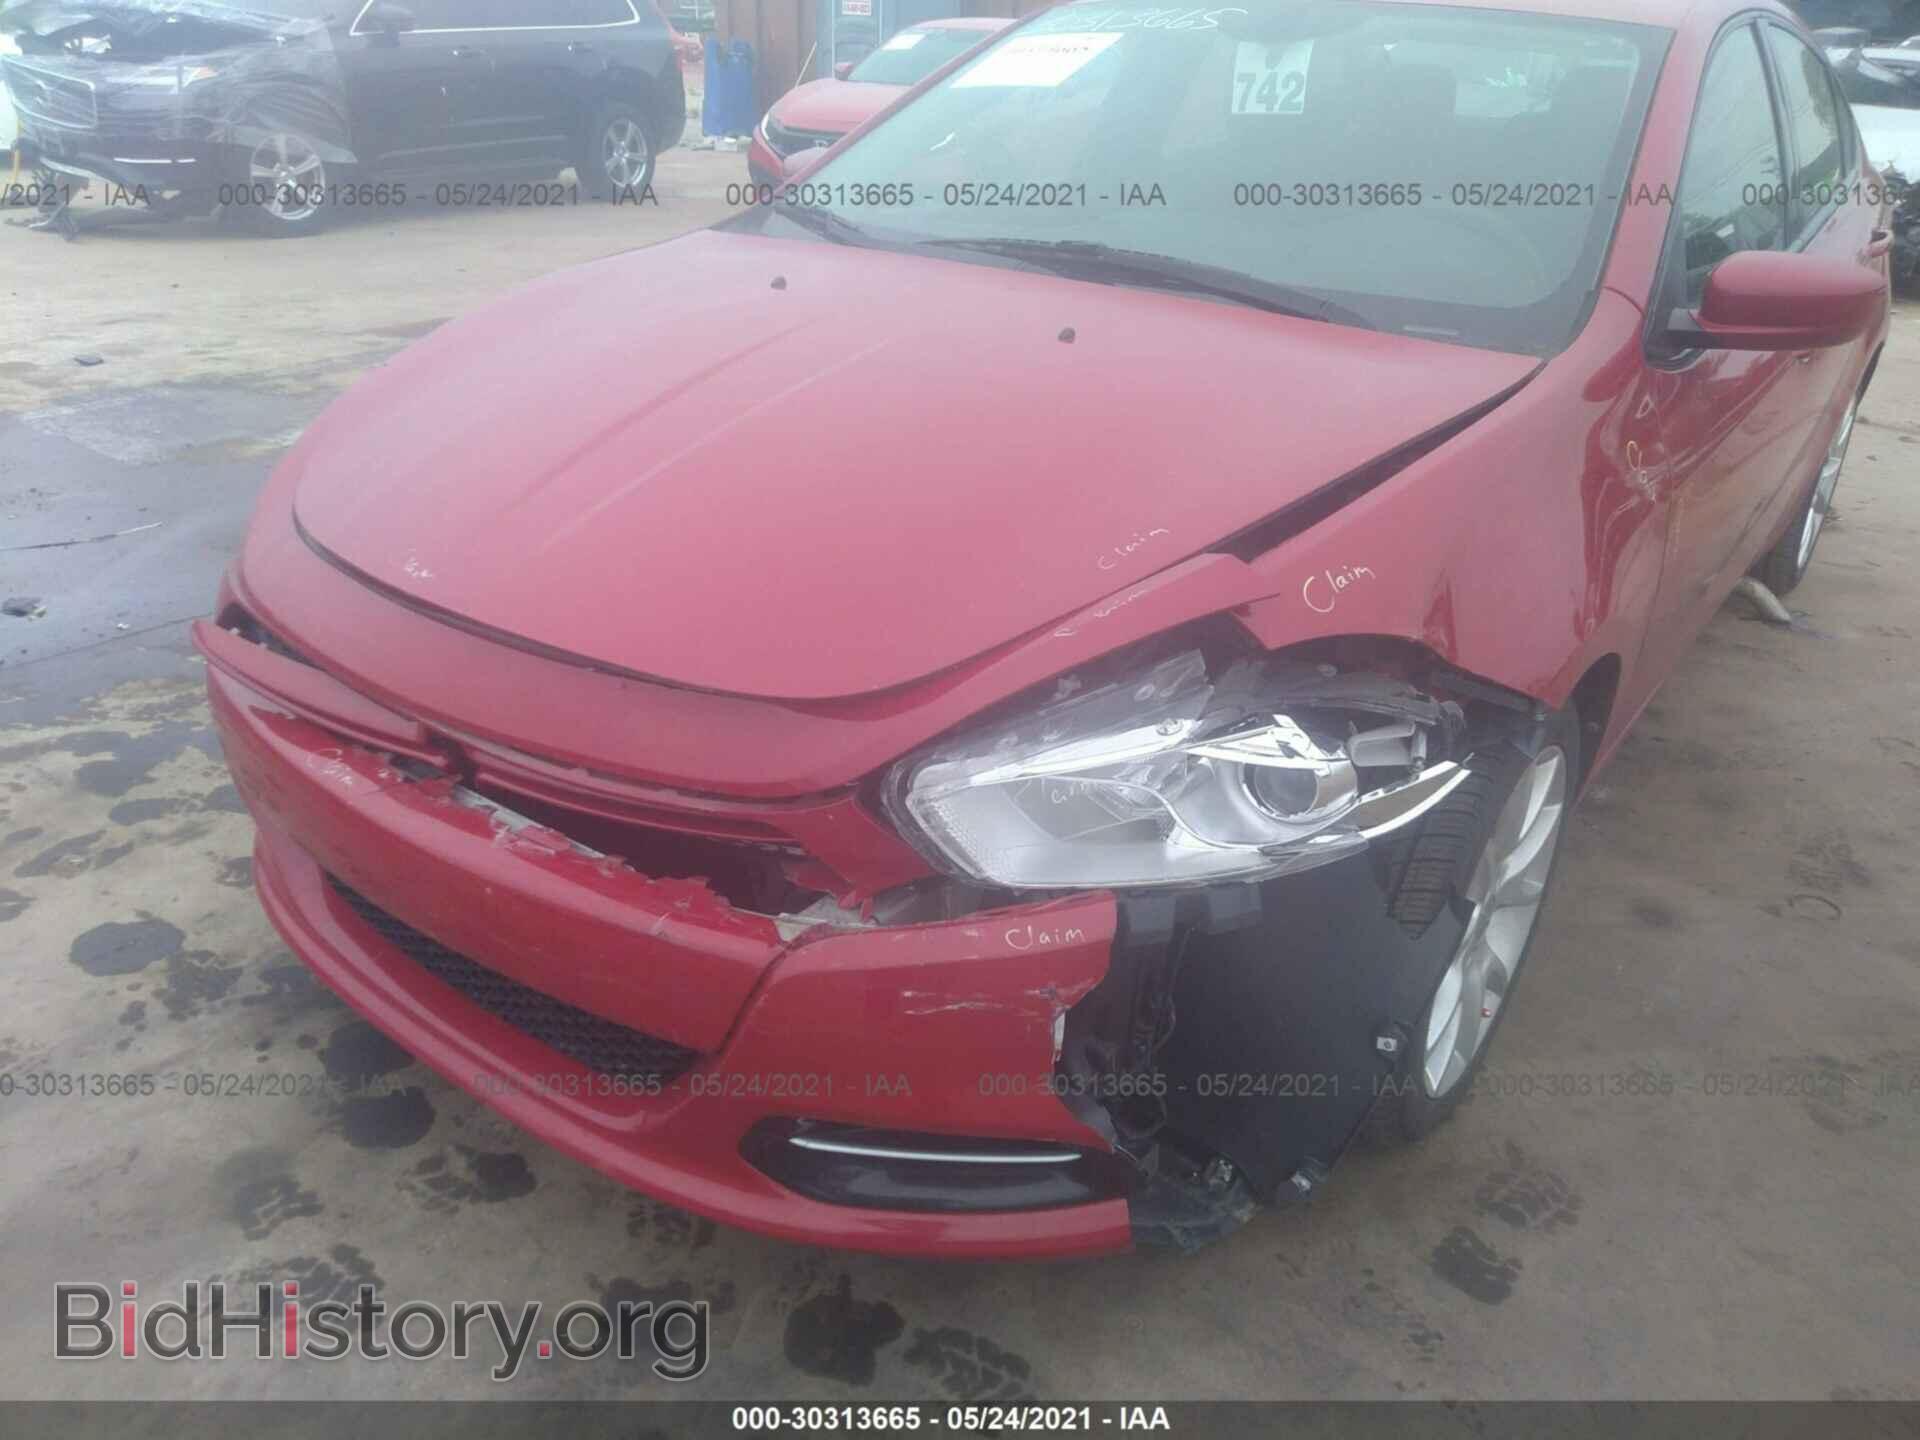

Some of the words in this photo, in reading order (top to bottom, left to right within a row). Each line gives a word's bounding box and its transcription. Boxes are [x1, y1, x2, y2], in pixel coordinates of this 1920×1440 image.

[1236, 72, 1304, 113] 742
[1303, 565, 1377, 612] Claim
[1005, 925, 1086, 950] Claim
